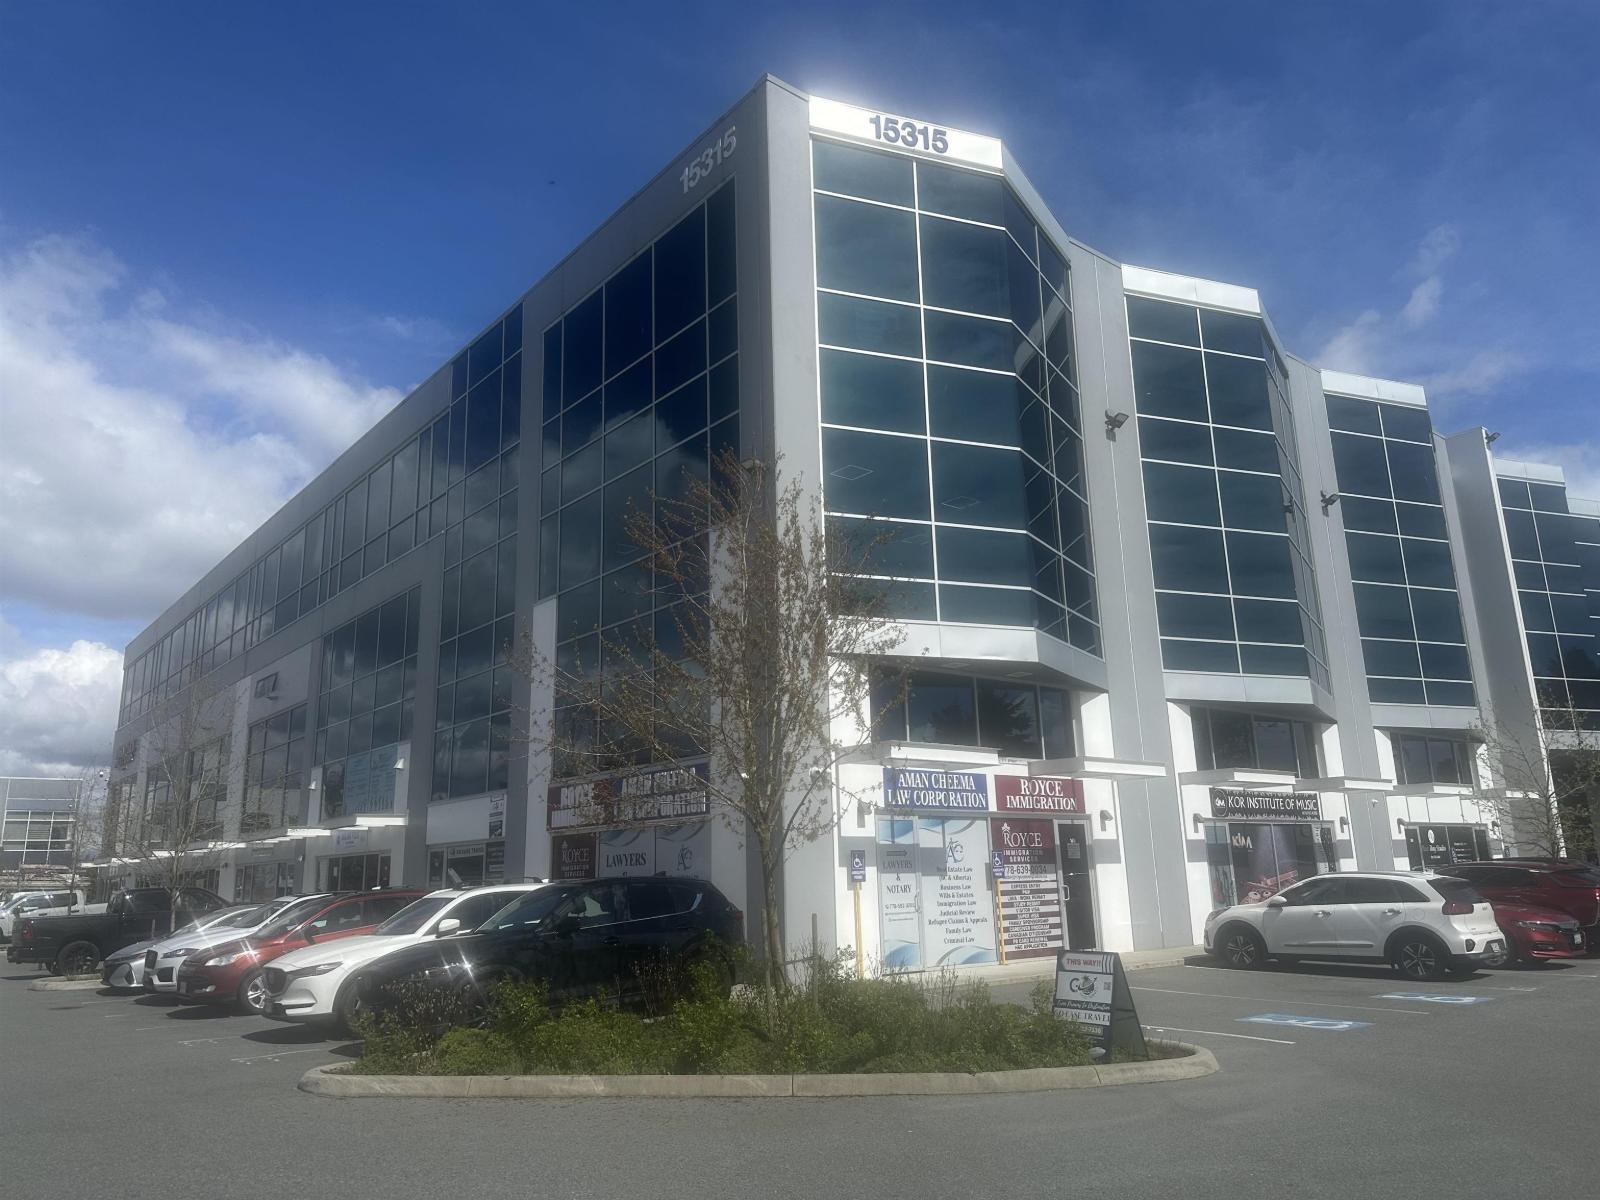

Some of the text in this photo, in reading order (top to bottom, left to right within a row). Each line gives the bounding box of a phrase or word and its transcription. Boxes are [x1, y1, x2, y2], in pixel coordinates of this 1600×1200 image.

[869, 114, 949, 154] 15315
[680, 125, 737, 194] 15315
[898, 773, 976, 791] AMAN CHEEMA
[1020, 779, 1064, 797] ROYCE
[888, 789, 987, 808] LAW CORPORATION
[1006, 795, 1077, 811] IMMIGRATION
[1228, 796, 1245, 808] KOR
[1246, 797, 1285, 810] INSTITUTE
[1285, 799, 1295, 810] OF
[1296, 799, 1318, 811] MUSIC
[1003, 832, 1043, 848] ROYCE
[561, 848, 590, 864] ROYCE
[606, 852, 647, 868] LAWYERS
[883, 860, 913, 870] LAWYERS
[886, 884, 912, 894] NOTARY
[1066, 958, 1083, 966] THIS
